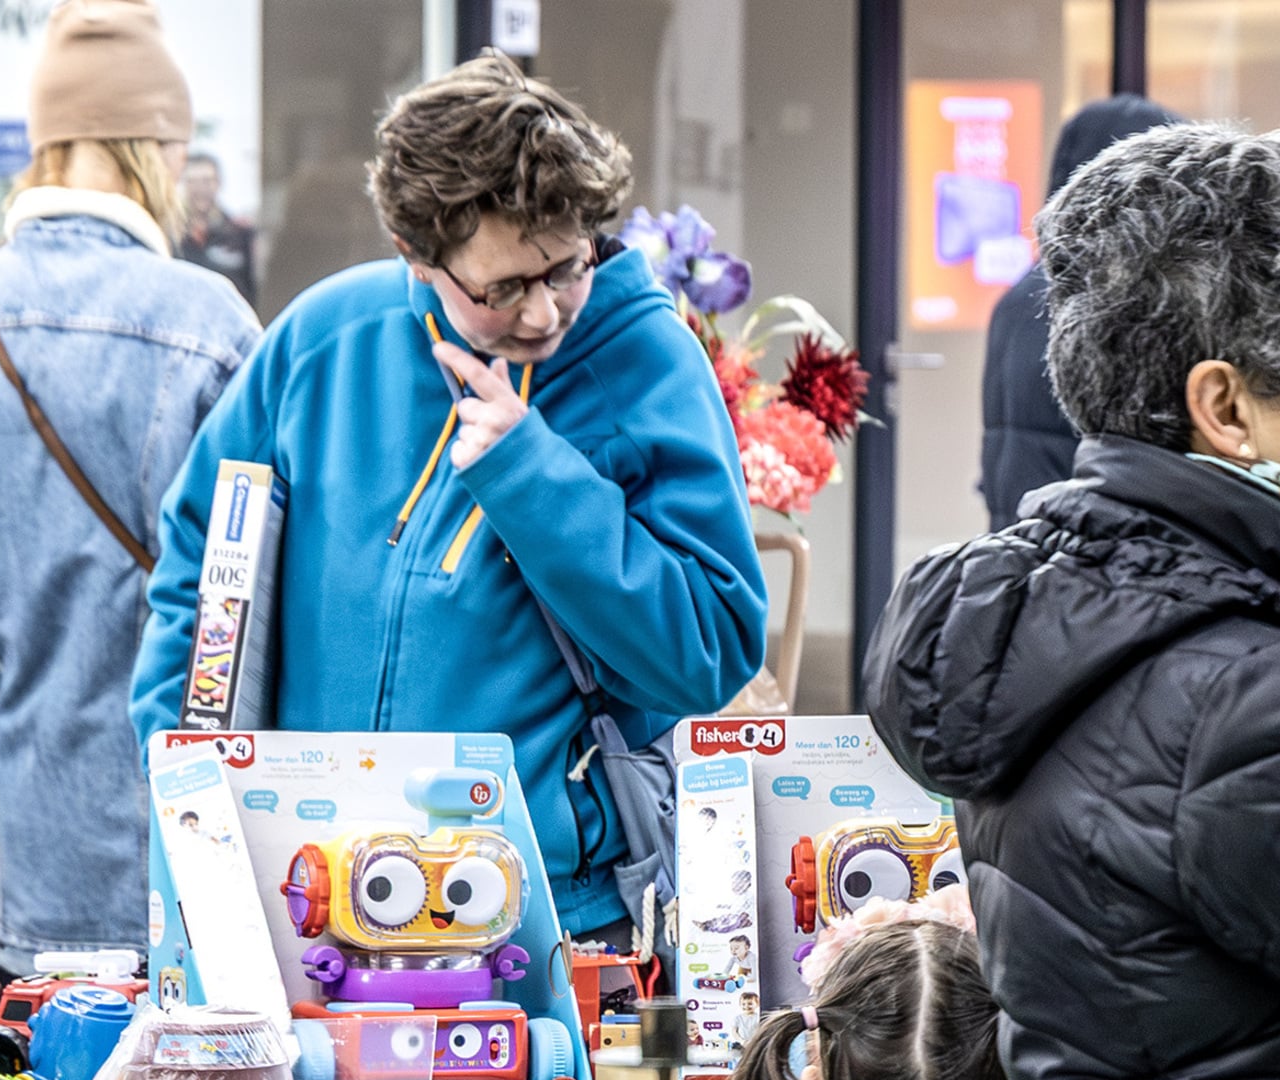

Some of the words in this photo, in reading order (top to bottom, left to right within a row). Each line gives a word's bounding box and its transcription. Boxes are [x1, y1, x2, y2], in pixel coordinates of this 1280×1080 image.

[212, 549, 250, 562] PUZZLE
[208, 563, 248, 589] 500
[762, 729, 776, 746] 4
[835, 735, 860, 748] 120
[235, 742, 246, 757] 4
[300, 751, 324, 763] 120
